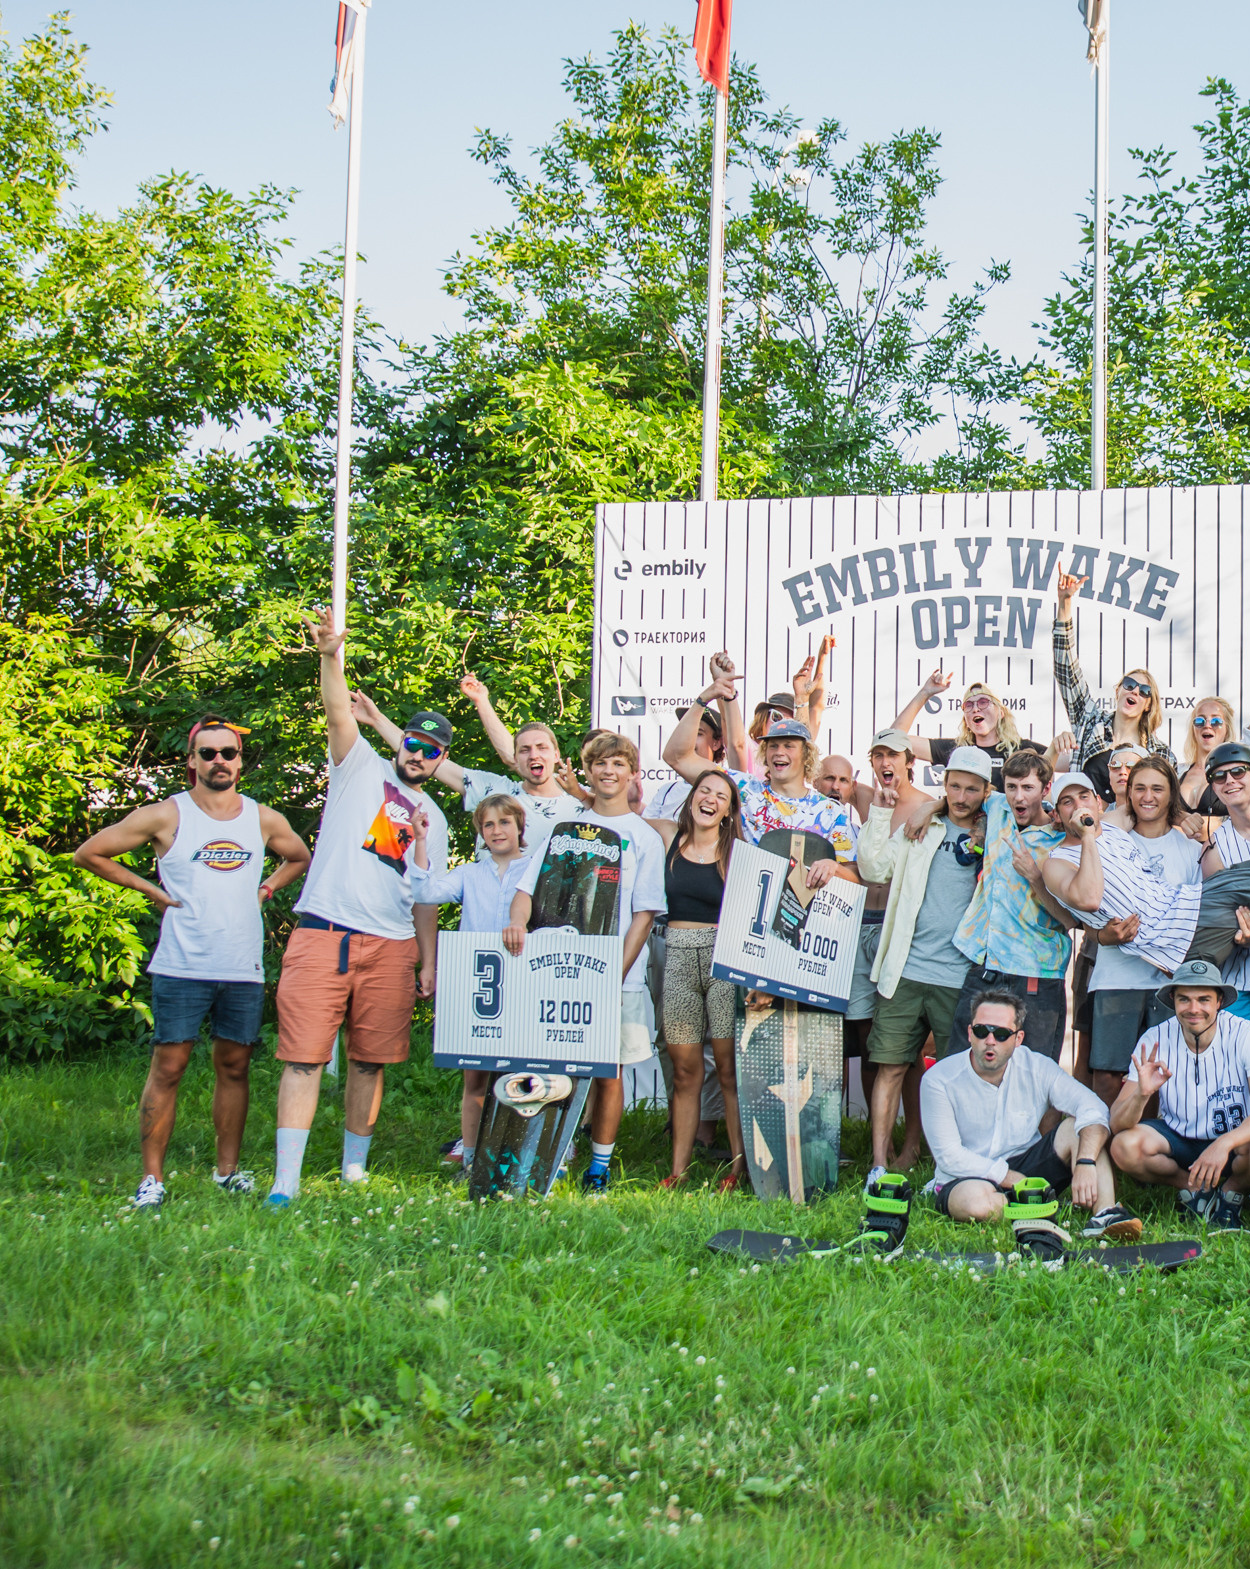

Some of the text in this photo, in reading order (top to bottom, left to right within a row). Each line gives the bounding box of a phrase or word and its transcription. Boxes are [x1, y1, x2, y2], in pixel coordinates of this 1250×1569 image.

[641, 558, 707, 580] embily
[782, 537, 1180, 627] EMBILY WAKE
[911, 595, 1042, 650] OPEN
[634, 631, 706, 644] ТРАЕКТОРИЯ
[650, 697, 696, 706] СТРОГИН
[197, 851, 249, 860] Dickies
[749, 869, 773, 940] 1
[812, 901, 833, 917] OPEN
[829, 893, 853, 918] WAKE
[742, 940, 766, 959] МЕСТО
[813, 934, 838, 962] 000
[529, 952, 607, 974] EMBILY WAKE
[554, 966, 581, 979] OPEN
[798, 957, 828, 977] РУБЛЕЙ
[473, 949, 505, 1020] 3
[539, 1000, 592, 1025] 12 000
[471, 1025, 502, 1039] МЕСТО
[546, 1028, 585, 1043] РУБЛЕЙ
[1212, 1103, 1246, 1137] 33
